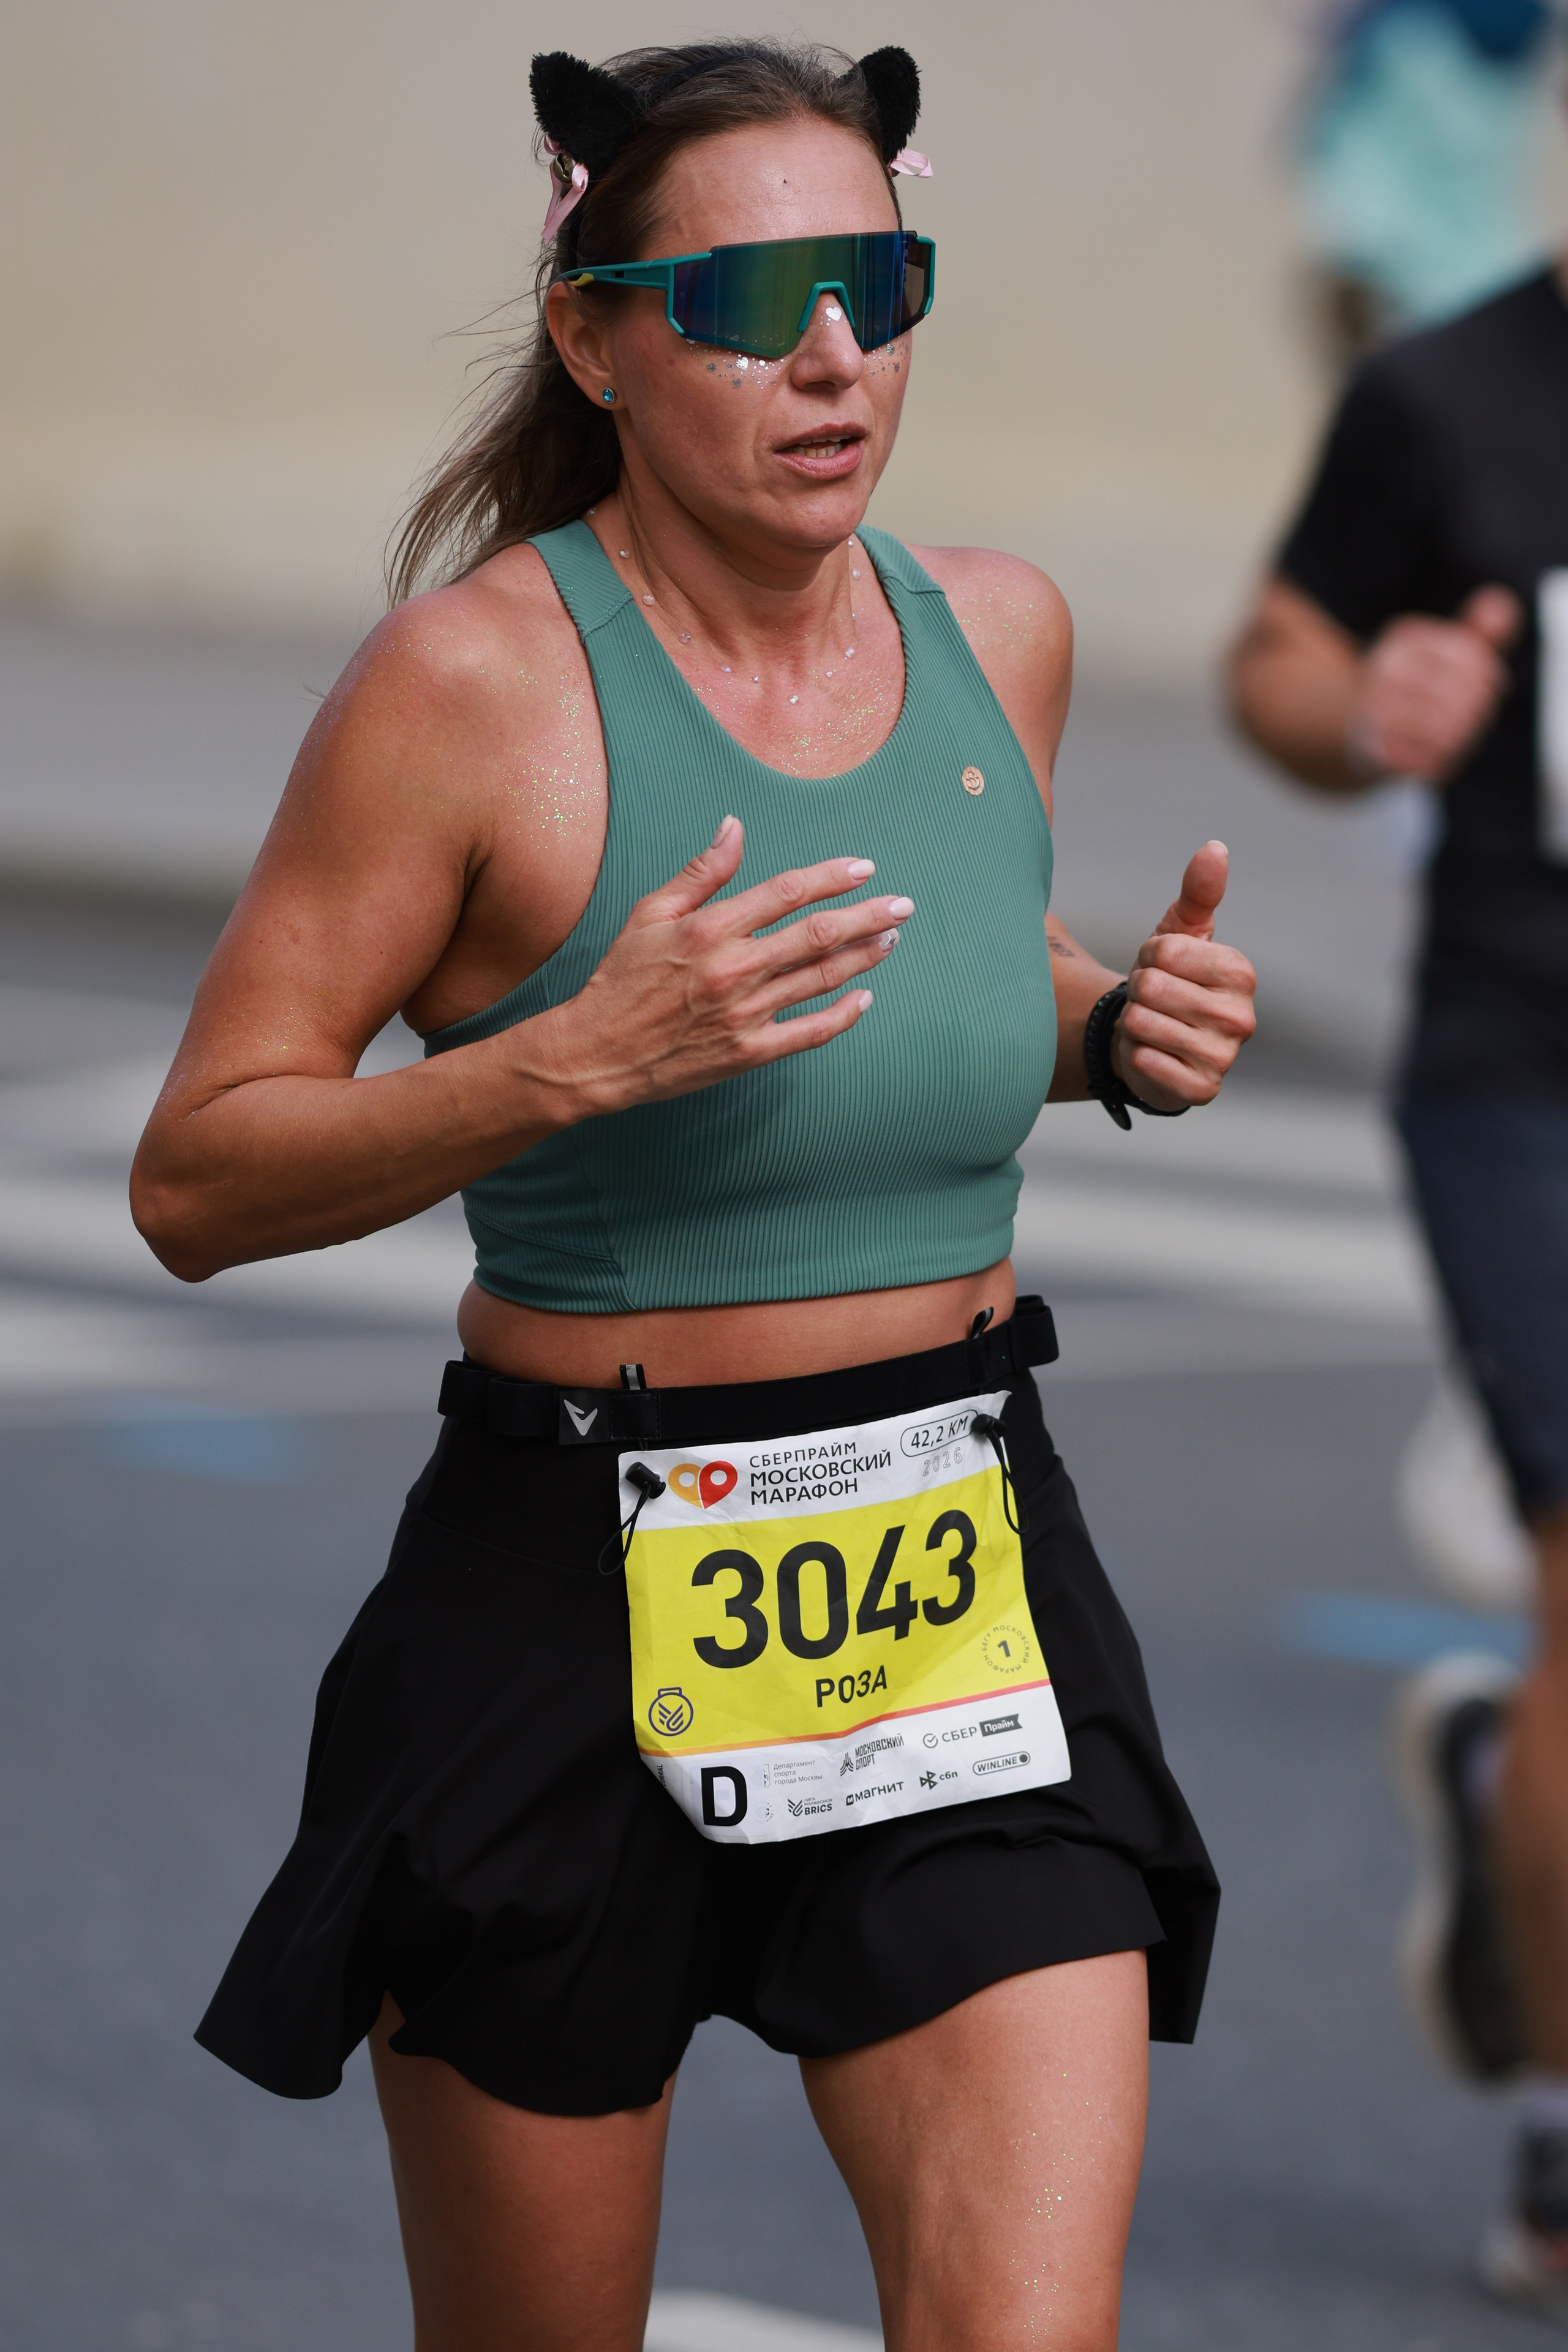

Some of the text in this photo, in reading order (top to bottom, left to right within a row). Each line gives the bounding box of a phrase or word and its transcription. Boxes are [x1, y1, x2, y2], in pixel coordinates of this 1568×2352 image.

[911, 1415, 968, 1449] 42,2 КМ
[749, 1441, 856, 1468] СБЕРПРАЙМ
[750, 1448, 891, 1487] МОСКОВСКИЙ
[922, 1447, 962, 1476] 2026
[751, 1477, 858, 1506] МАРАФОН
[691, 1509, 978, 1669] 3043
[993, 1624, 1030, 1664] МОСКОВСКИЙ
[997, 1639, 1011, 1657] 1
[984, 1654, 1022, 1673] МАРАФОН
[815, 1665, 888, 1708] РОЗА
[941, 1719, 1014, 1743] СБЕР Прайм
[855, 1733, 904, 1758] МОСКОВСКИЙ
[773, 1760, 815, 1771] Департамент
[856, 1754, 875, 1770] СПОРТ
[978, 1756, 1017, 1772] WINLINE
[774, 1777, 796, 1785] города
[701, 1766, 747, 1826] D
[805, 1803, 832, 1815] BRICS
